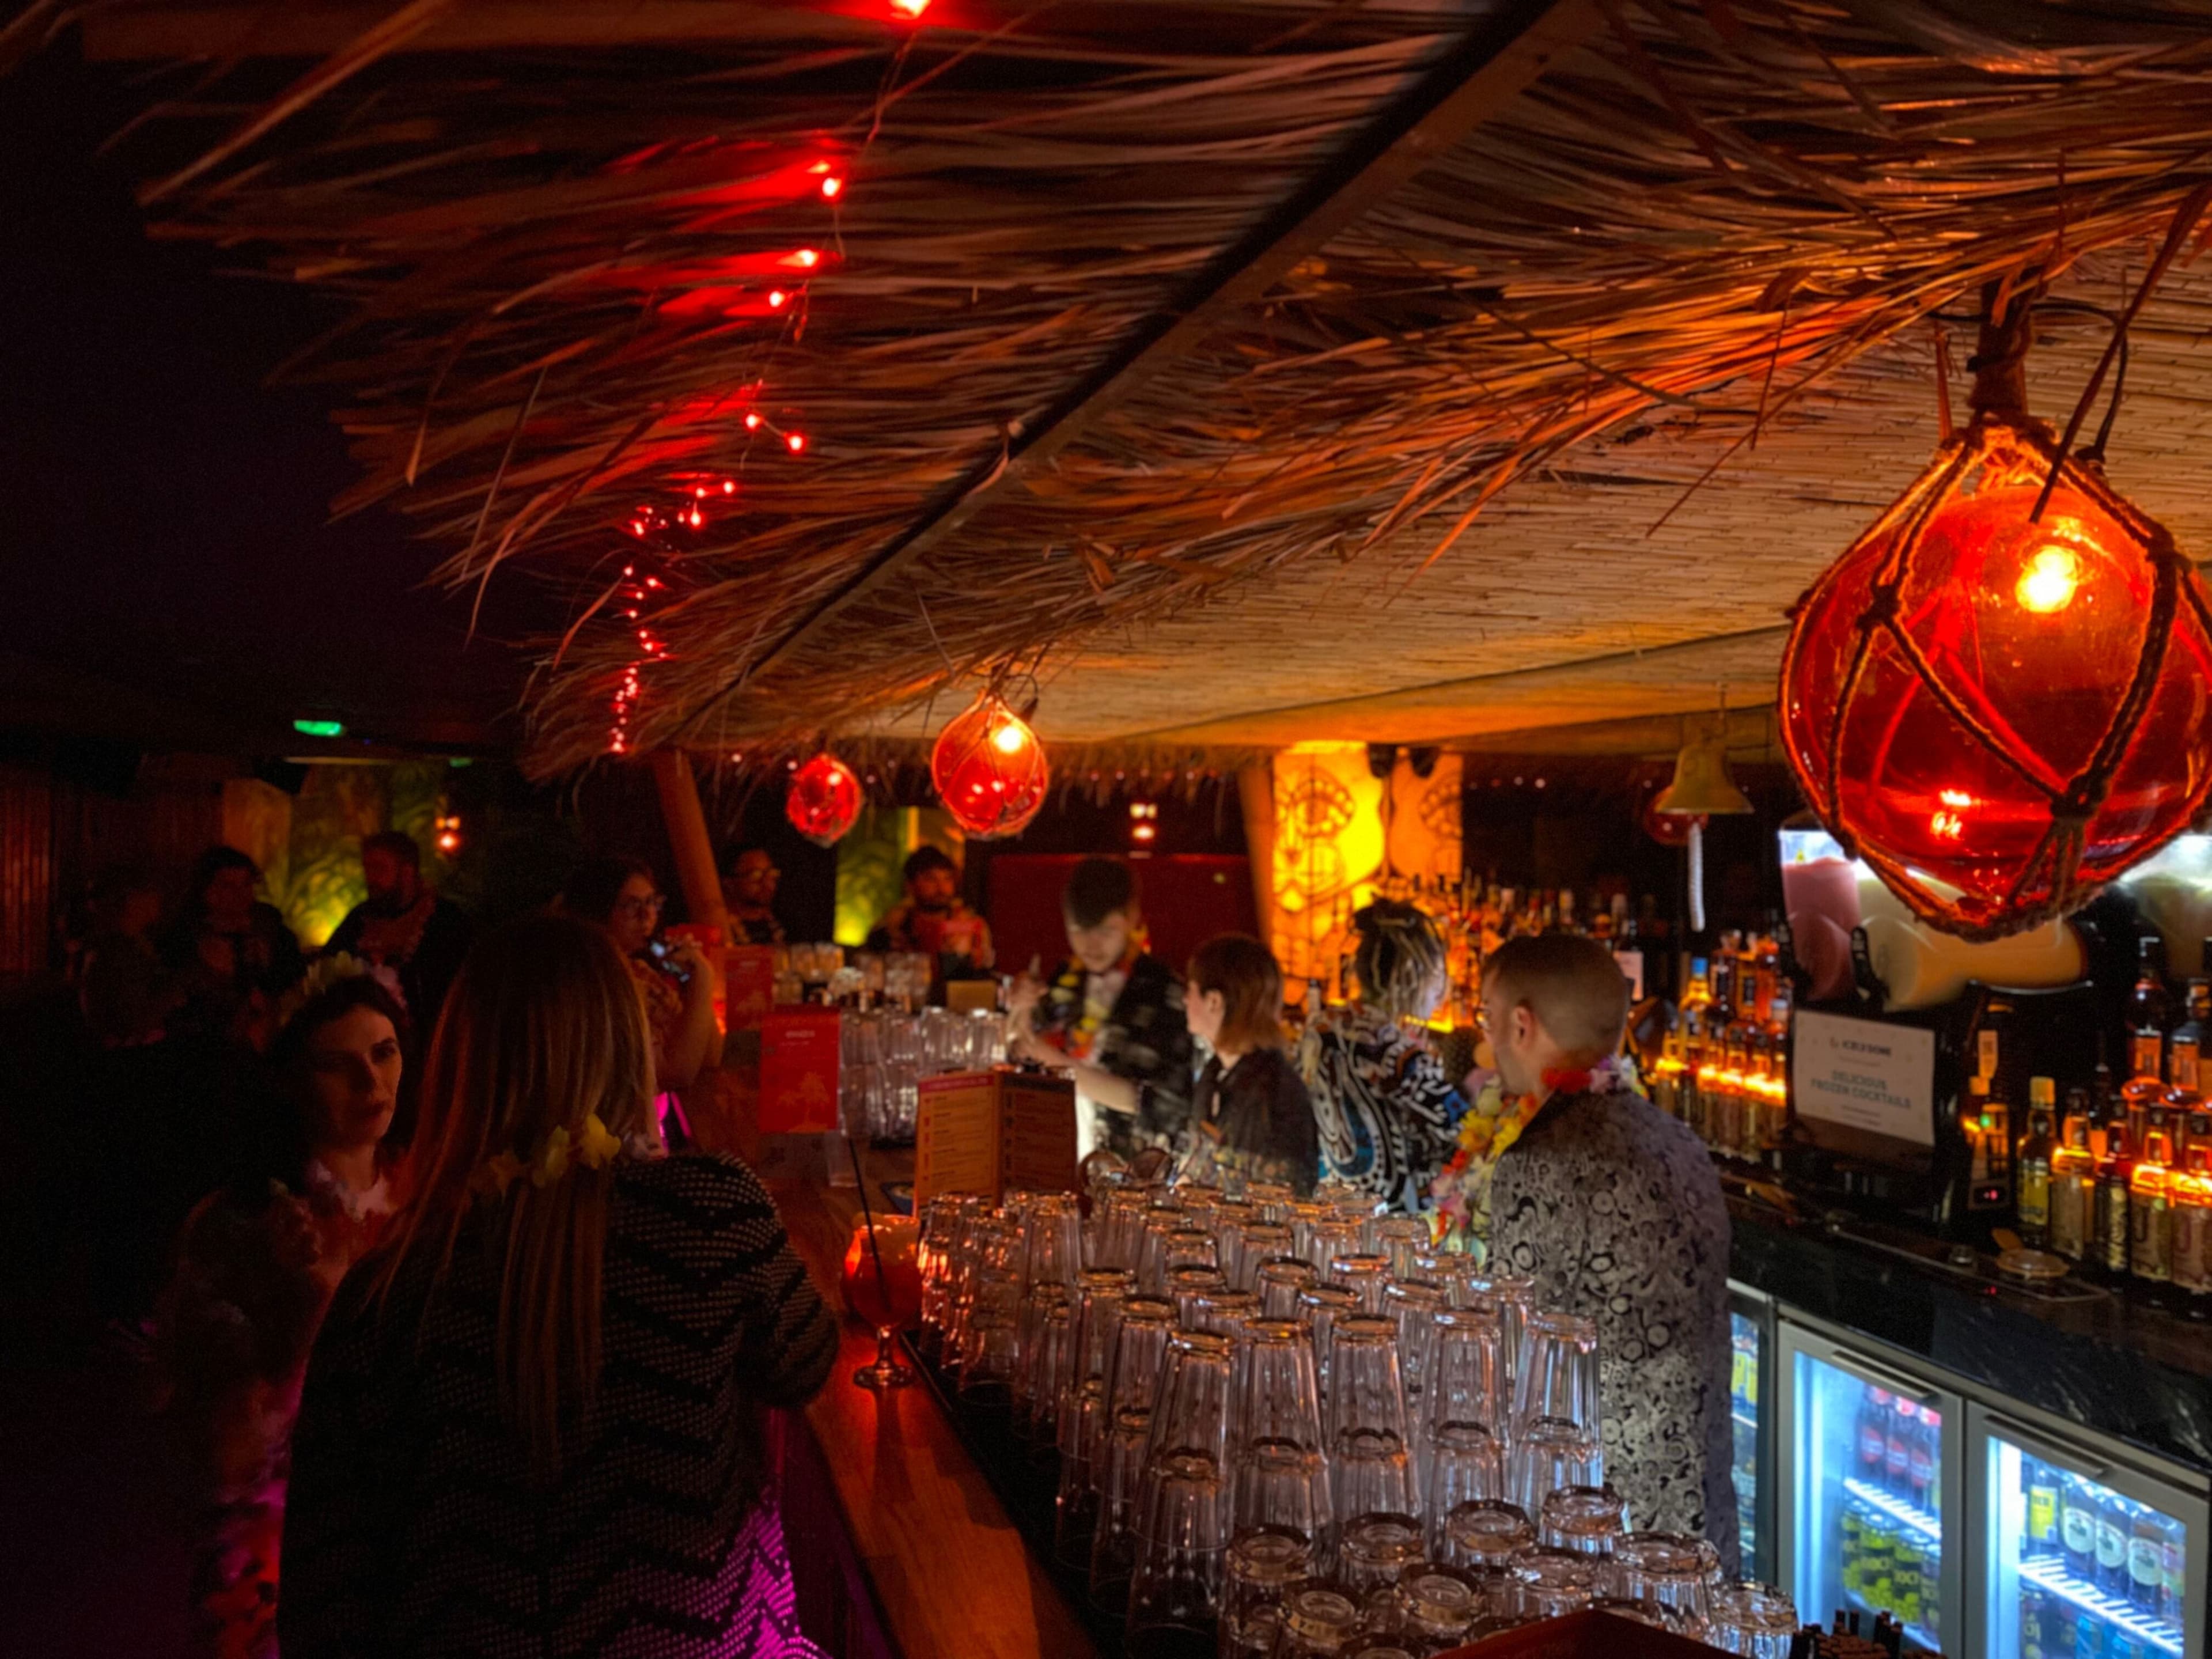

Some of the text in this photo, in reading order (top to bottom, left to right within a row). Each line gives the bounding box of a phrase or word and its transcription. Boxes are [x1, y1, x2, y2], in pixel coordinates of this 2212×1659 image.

[1831, 1069, 1887, 1090] DELICIOUS
[1810, 1078, 1911, 1109] FROZEN COCKTAILS
